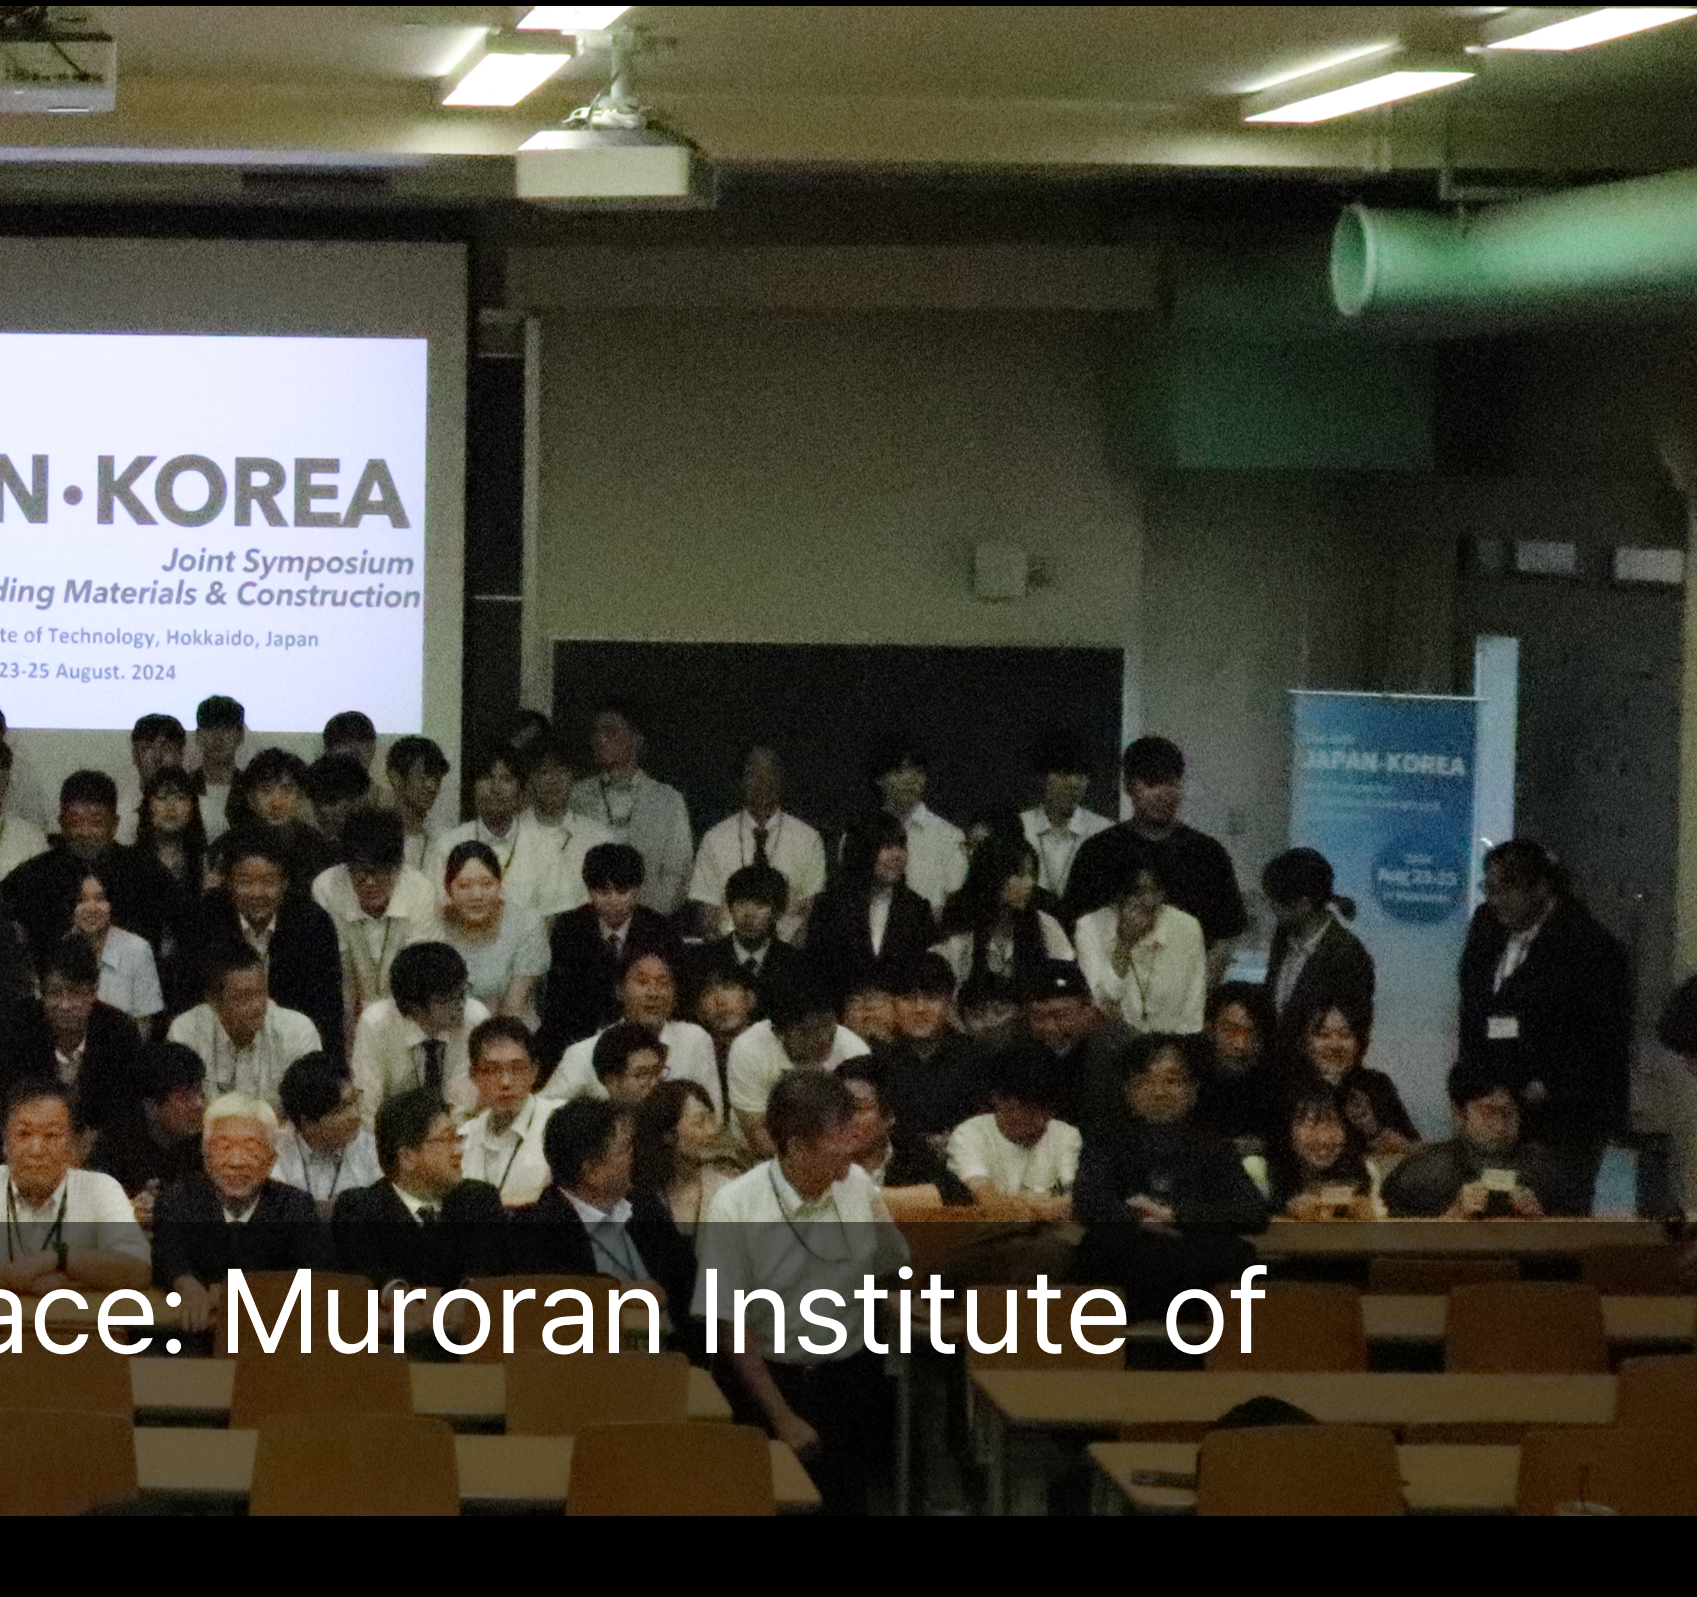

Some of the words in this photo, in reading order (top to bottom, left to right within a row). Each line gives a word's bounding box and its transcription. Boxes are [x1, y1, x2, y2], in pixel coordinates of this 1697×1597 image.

[161, 547, 236, 573] Joint
[242, 547, 415, 581] Symposium
[63, 579, 197, 606] Materials
[205, 580, 227, 606] &
[236, 581, 421, 609] Construction
[23, 626, 43, 644] of
[48, 627, 160, 650] Technology,
[166, 629, 260, 649] Hokkaido,
[265, 631, 319, 651] Japan
[55, 663, 125, 684] August.
[131, 664, 177, 681] 2024
